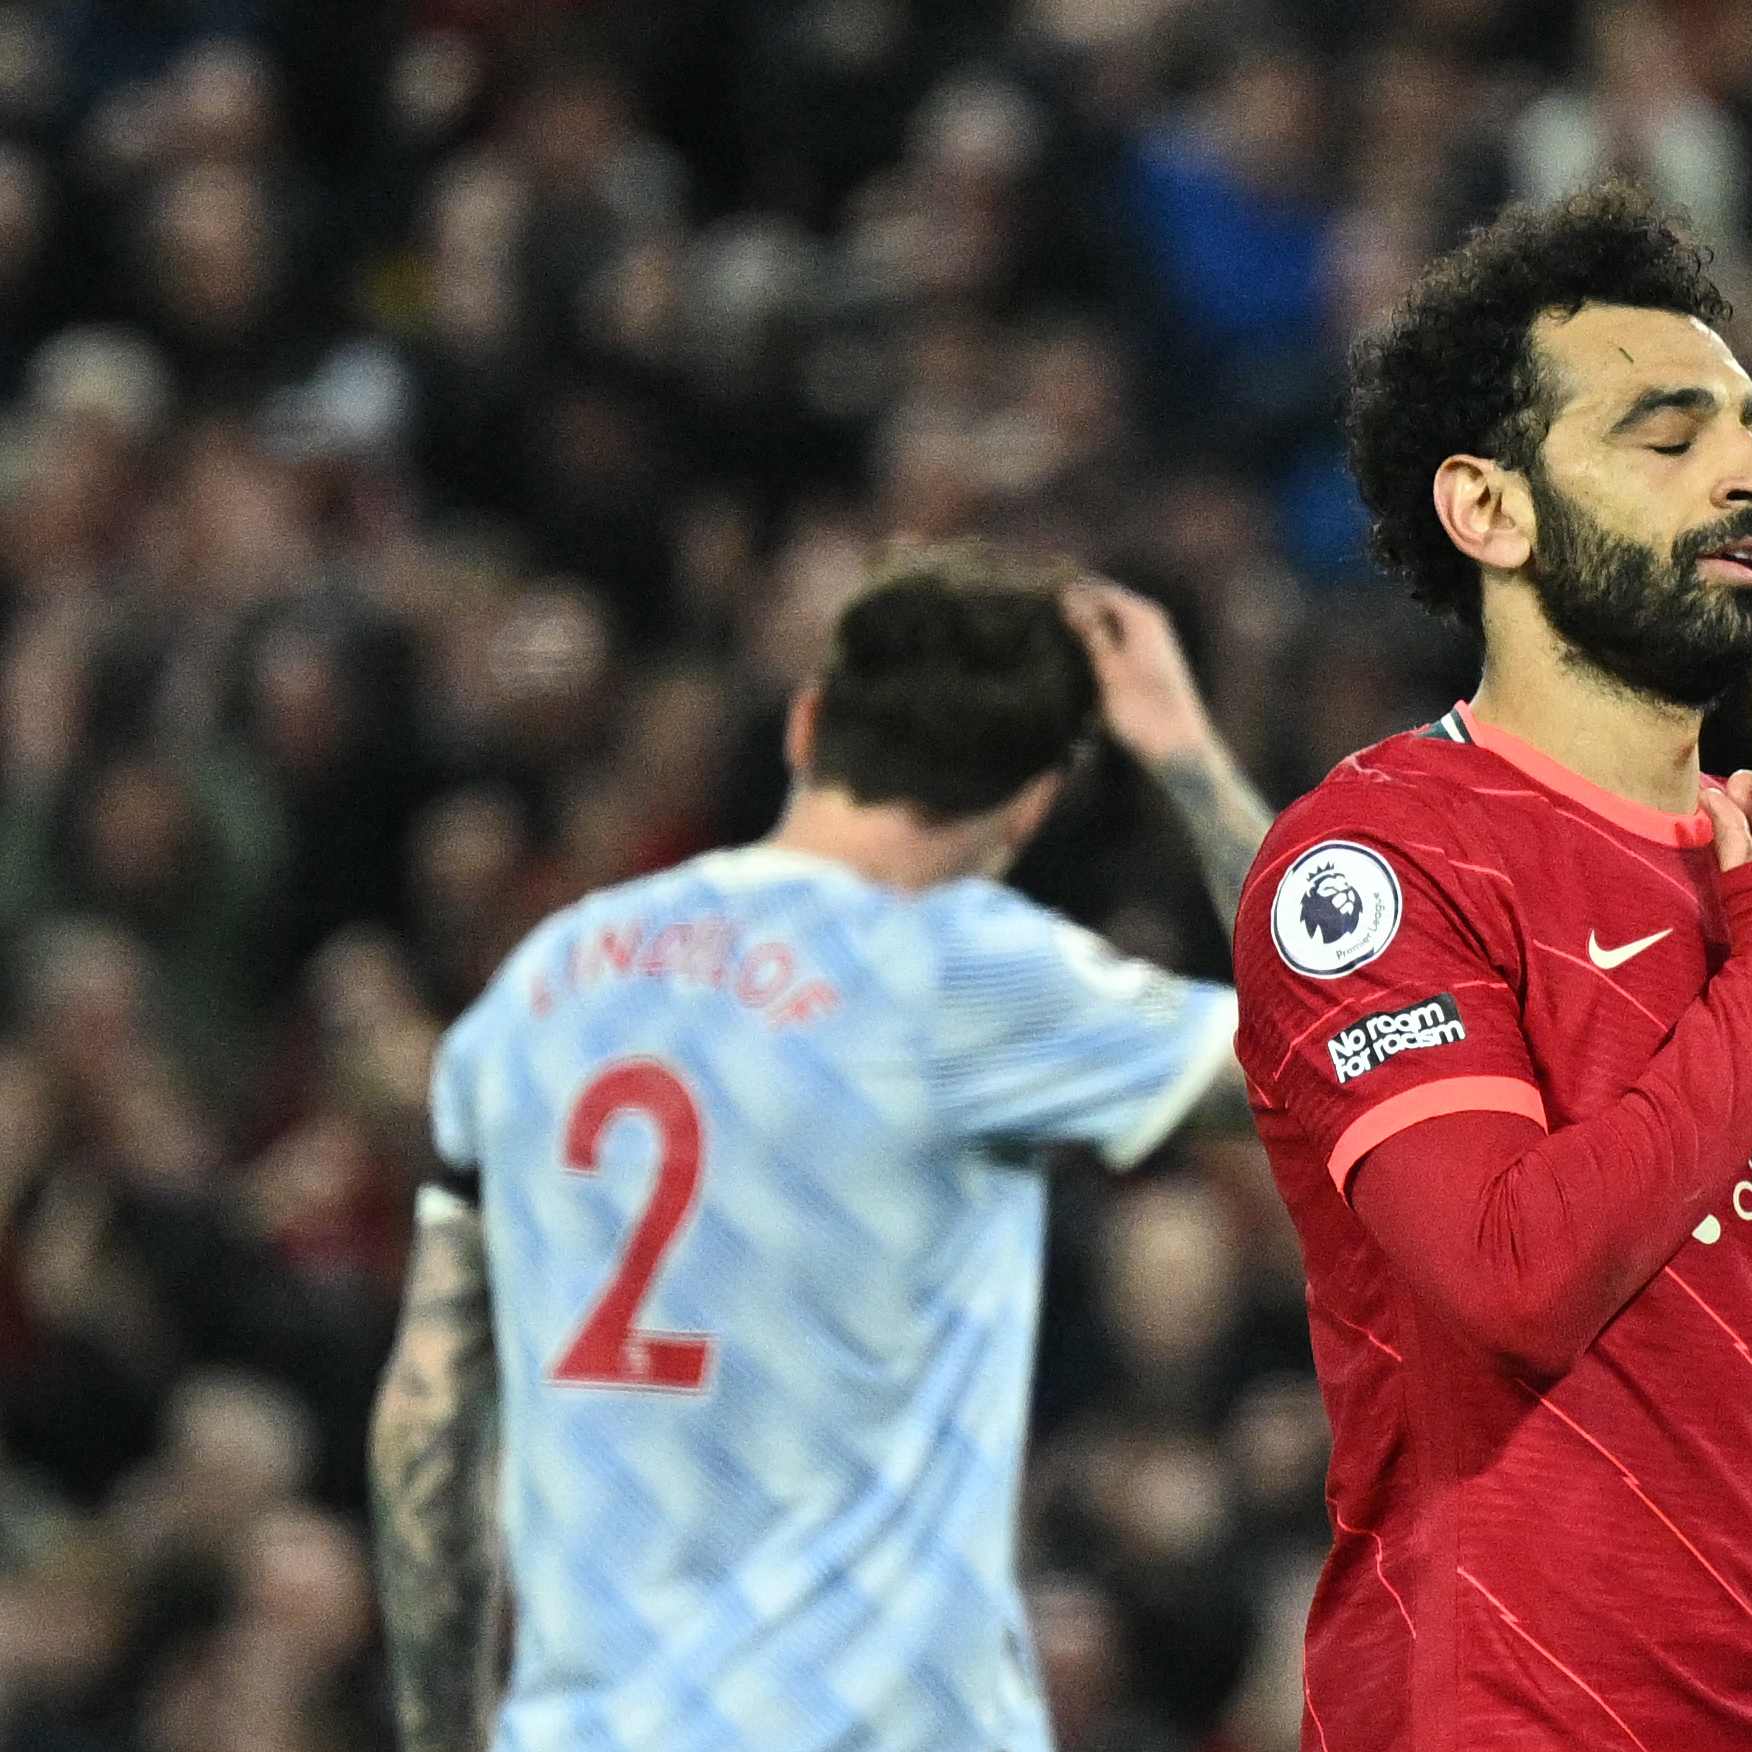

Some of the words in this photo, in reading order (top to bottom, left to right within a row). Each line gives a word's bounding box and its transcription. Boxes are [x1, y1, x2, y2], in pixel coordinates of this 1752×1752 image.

[1368, 892, 1386, 932] League
[1328, 1029, 1367, 1064] No
[1366, 1002, 1446, 1041] room
[1336, 1047, 1372, 1084] for
[1373, 1020, 1467, 1062] racism
[545, 1053, 720, 1398] 2
